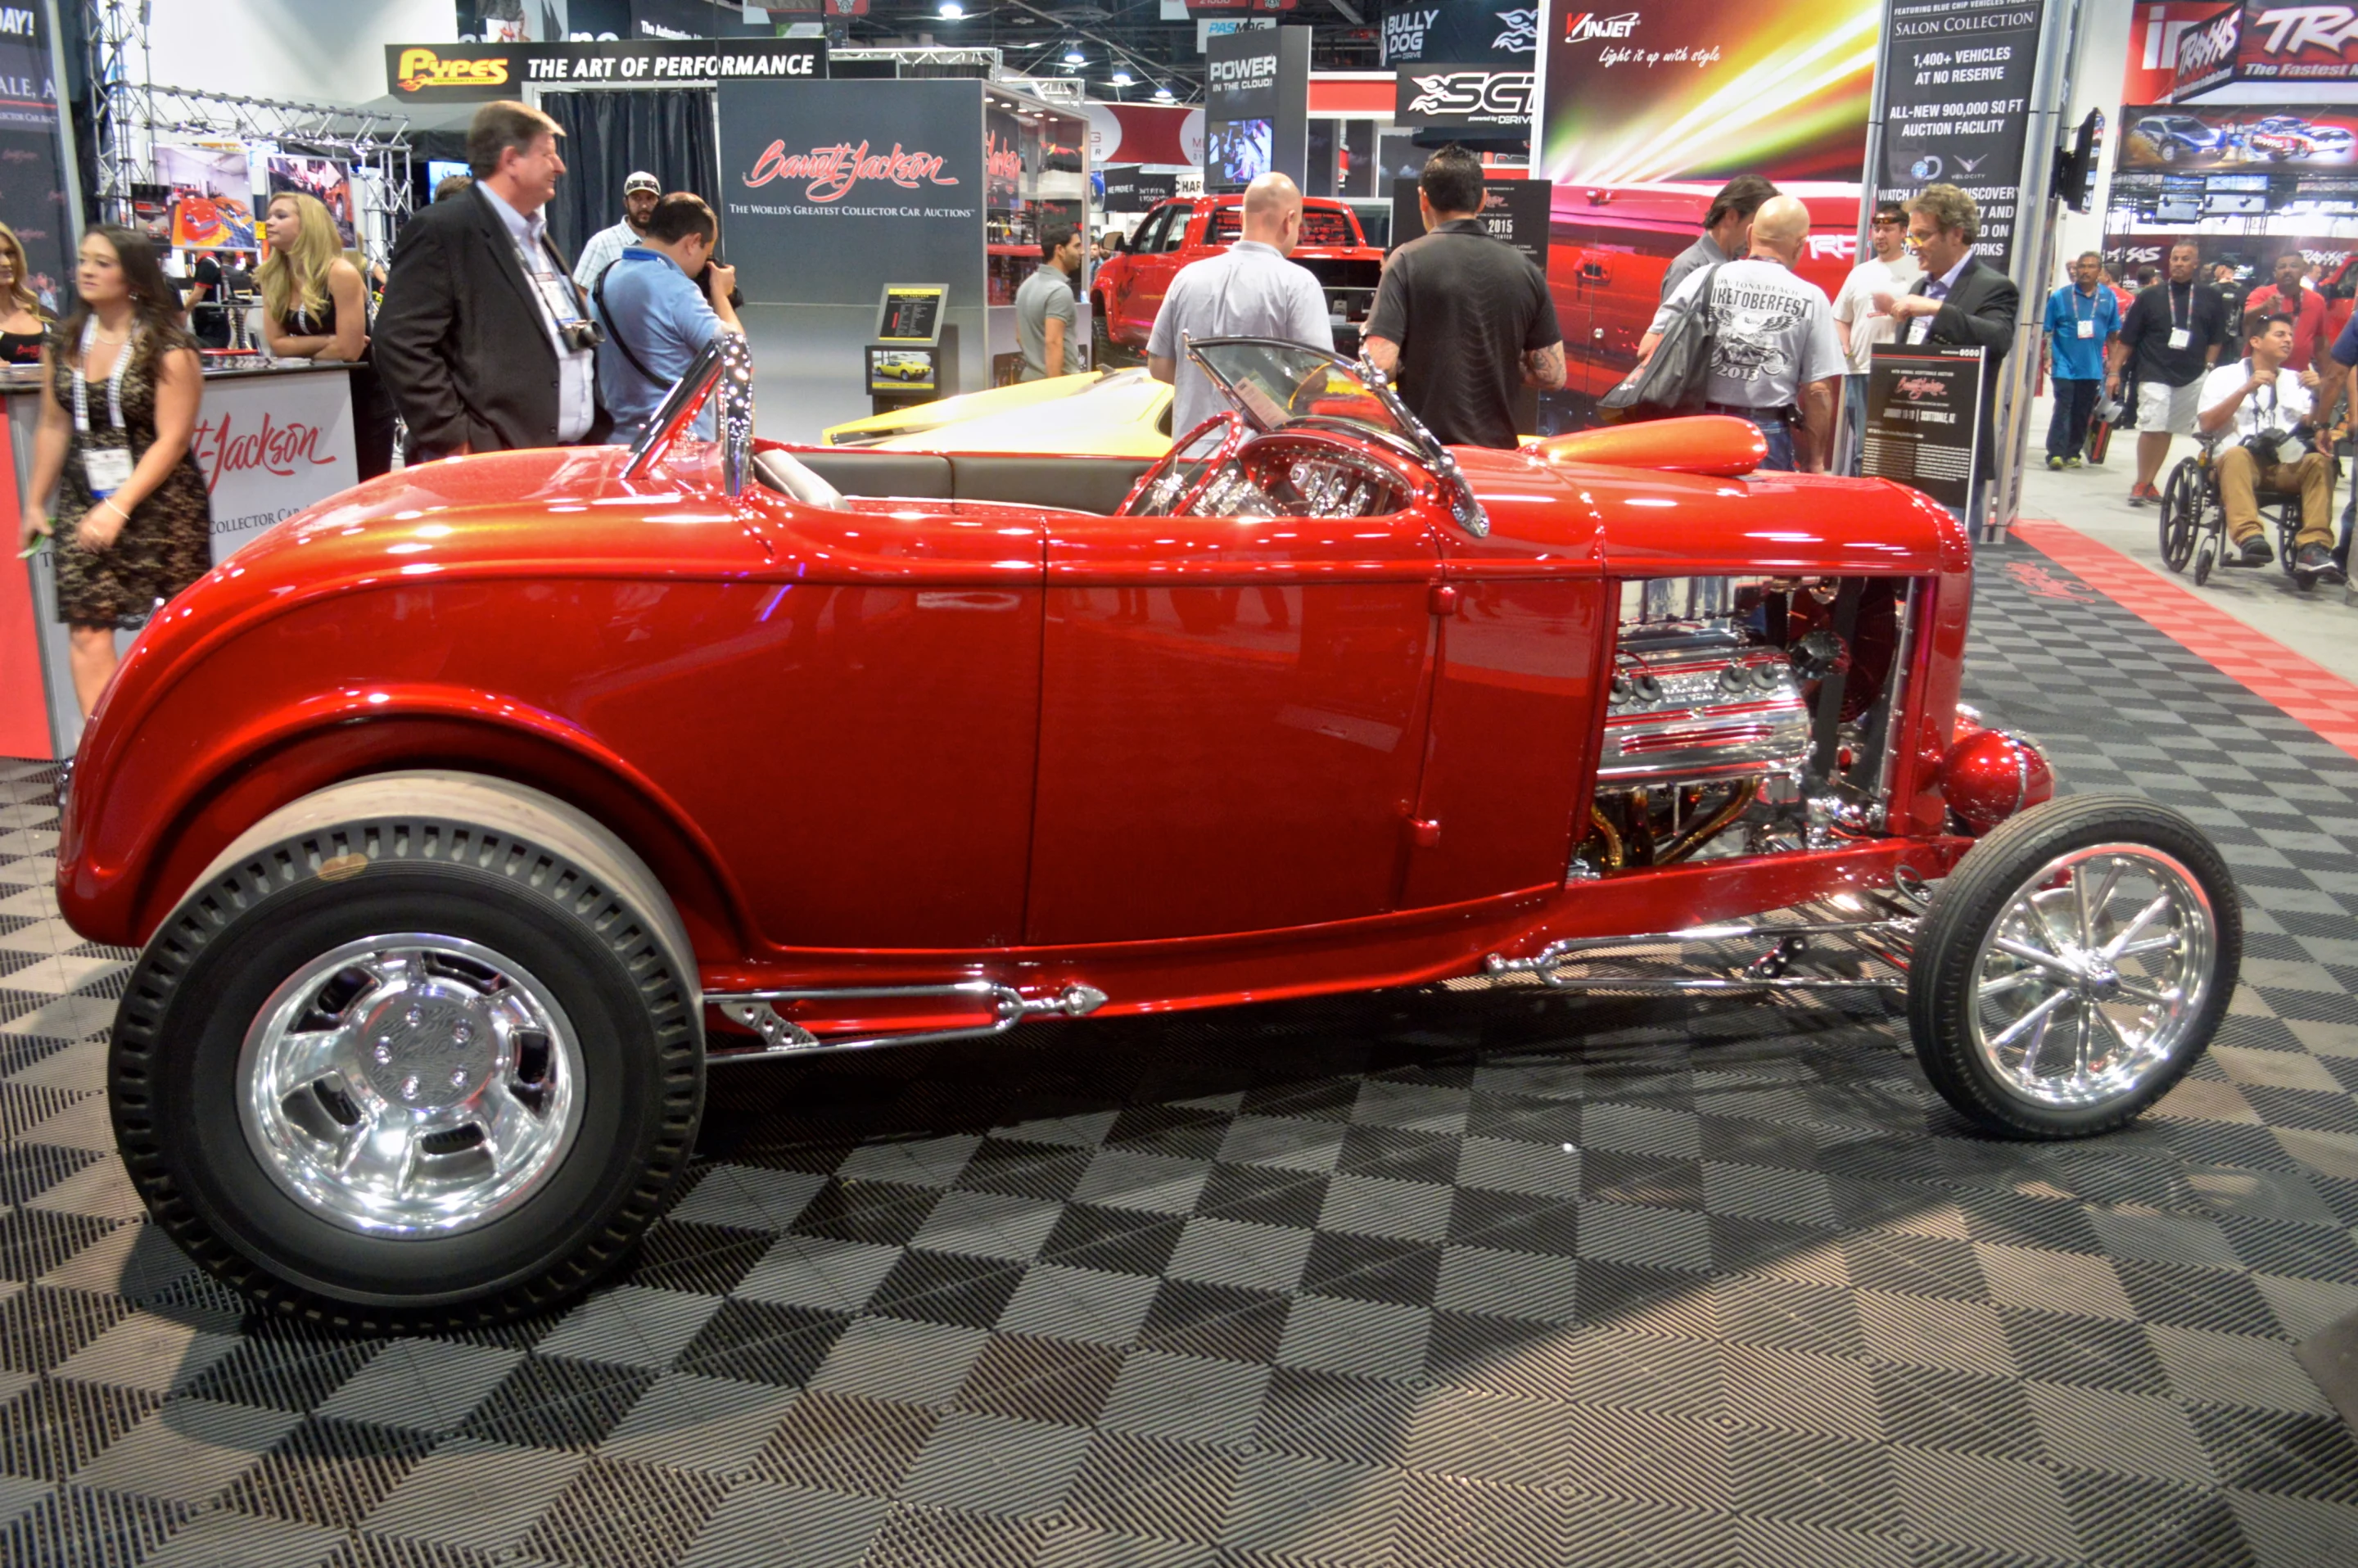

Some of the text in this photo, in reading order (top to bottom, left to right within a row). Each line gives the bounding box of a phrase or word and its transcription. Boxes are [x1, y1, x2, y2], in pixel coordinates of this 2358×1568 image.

[1894, 5, 1931, 16] FEATURING
[1933, 3, 1949, 11] BLUE
[0, 7, 34, 36] AY!
[641, 20, 655, 35] The
[1387, 9, 1439, 35] BULLY
[1565, 12, 1639, 43] VINJET
[1895, 11, 2034, 36] SALON COLLECTION
[1389, 31, 1424, 53] DOG
[528, 54, 815, 78] THE ART OF PERFORMANCE
[1598, 46, 1631, 68] Light
[1633, 48, 1645, 62] it
[1663, 46, 1687, 62] with
[1691, 45, 1720, 68] style
[1913, 46, 2012, 69] 1,400+ VEHICLES
[1210, 56, 1276, 81] POWER
[1915, 66, 2004, 85] AT NO RESERVE
[2244, 63, 2278, 76] The
[2279, 63, 2348, 77] Fastest
[1213, 78, 1273, 92] IN THE CLOUD!
[1890, 99, 2024, 120] ALL-NEW 900,000 SQ FT
[1902, 120, 2004, 138] AUCTION FACILITY
[1878, 189, 1909, 201] WATCH
[730, 204, 749, 214] THE
[750, 205, 792, 215] WORLD'S
[793, 206, 839, 216] GREATEST
[842, 206, 898, 217] COLLECTOR
[900, 206, 920, 217] CAR
[1988, 206, 2014, 219] AND
[1488, 219, 1513, 233] 2015
[1992, 224, 2008, 237] ON
[1716, 365, 1759, 382] 2013
[209, 512, 276, 535] COLLECTOR
